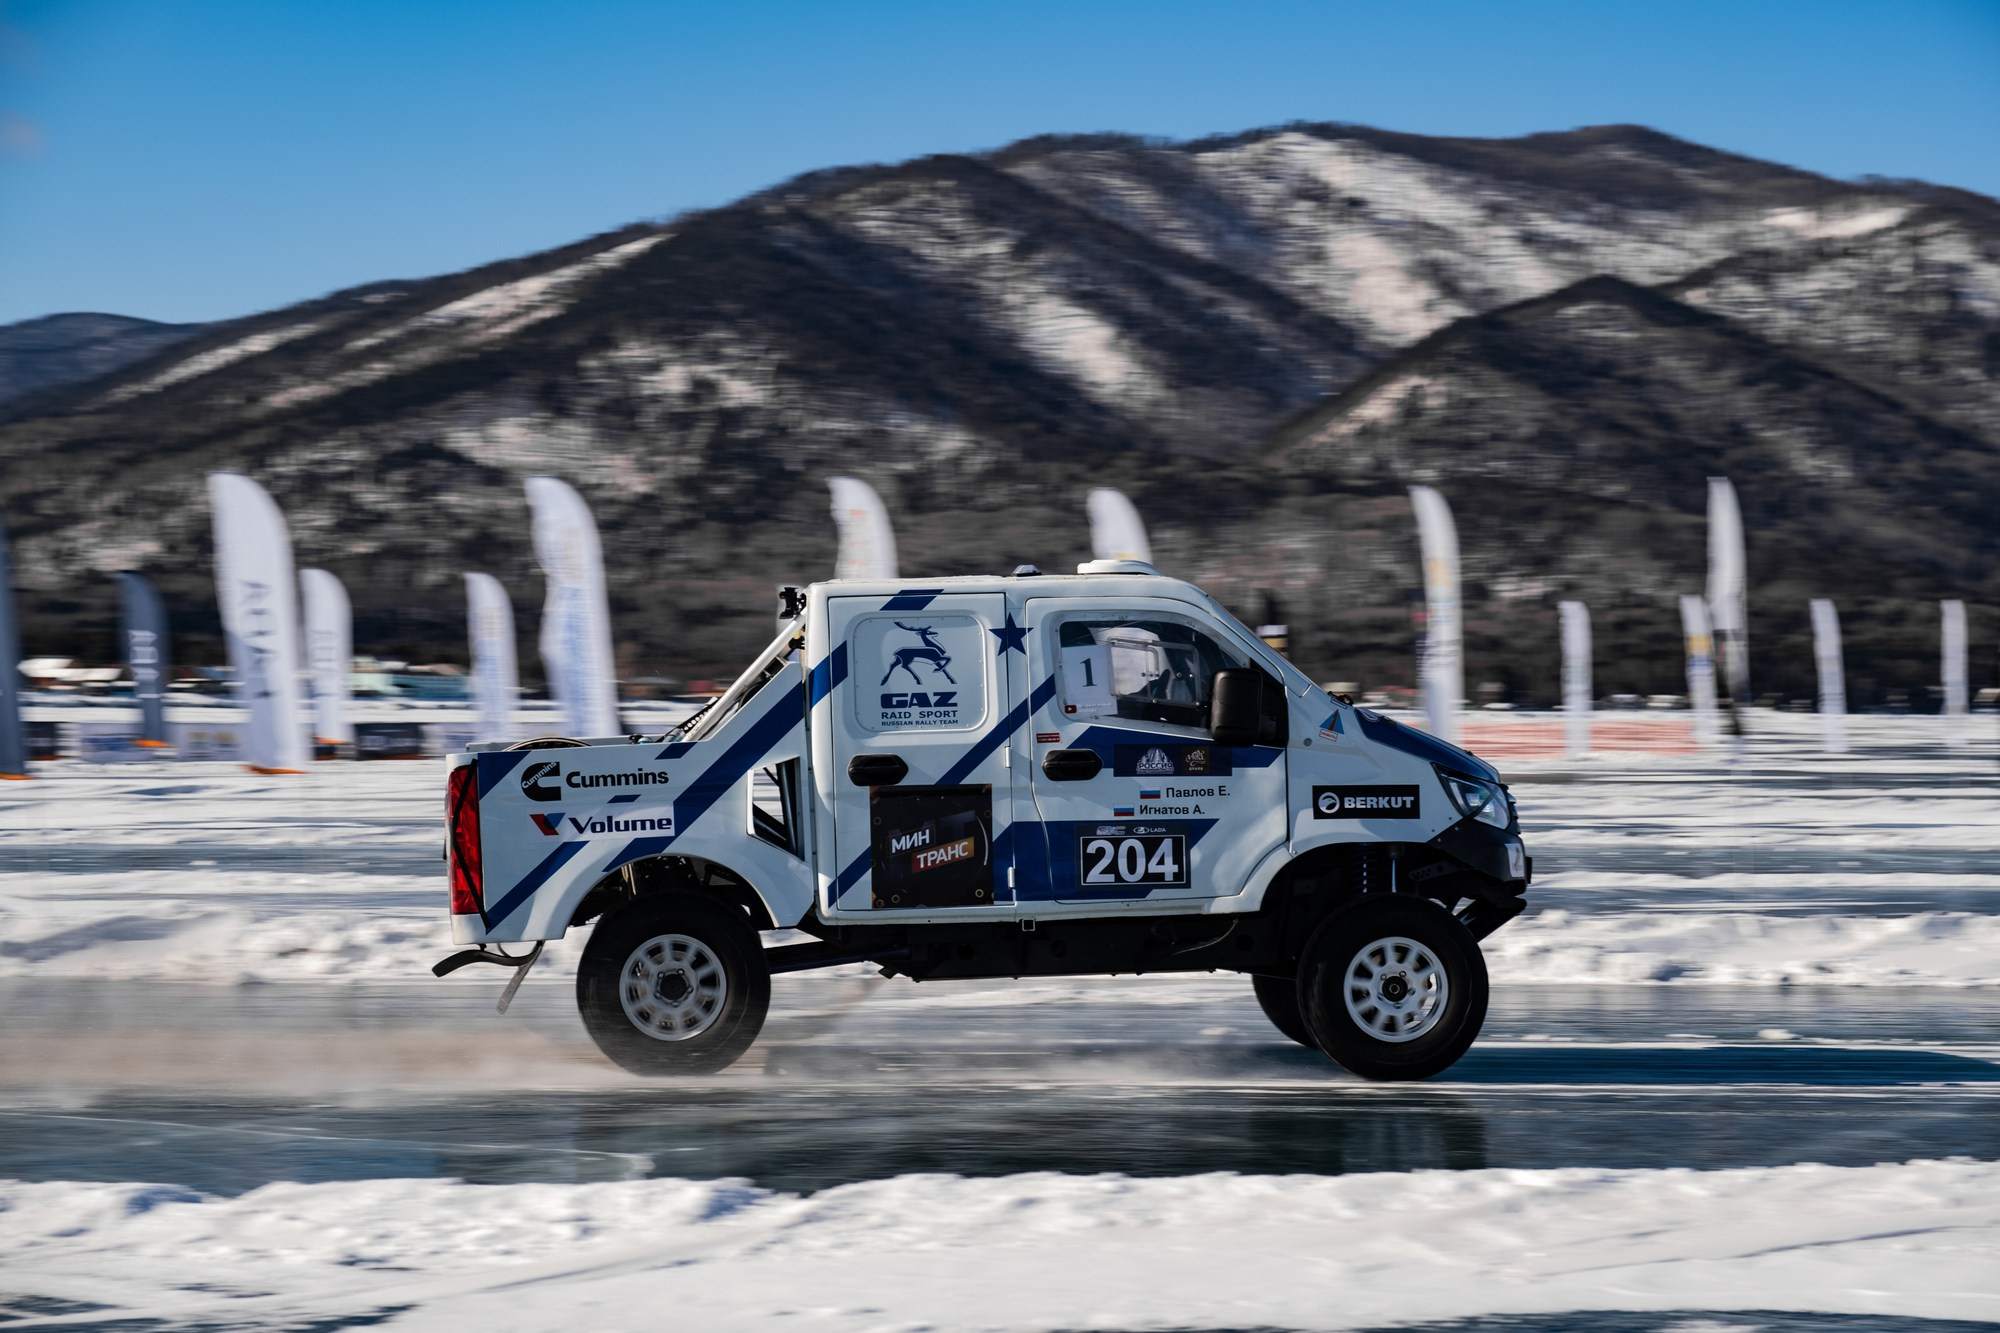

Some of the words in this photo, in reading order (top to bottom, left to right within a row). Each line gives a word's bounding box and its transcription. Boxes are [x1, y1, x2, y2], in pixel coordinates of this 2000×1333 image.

[1080, 657, 1097, 687] 1
[881, 692, 958, 709] GAZ
[881, 711, 911, 719] RAID
[919, 710, 958, 718] SPORT
[521, 762, 557, 789] Cummins
[566, 767, 669, 788] Cummins
[1166, 787, 1214, 798] Павлов
[1218, 786, 1230, 796] Е.
[1344, 796, 1414, 809] BERKUT
[1139, 805, 1189, 815] Игнатов
[1192, 804, 1205, 815] А.
[568, 814, 673, 835] Volume
[891, 829, 930, 853] МИН
[917, 841, 969, 869] ТРАНС
[1086, 837, 1179, 883] 204
